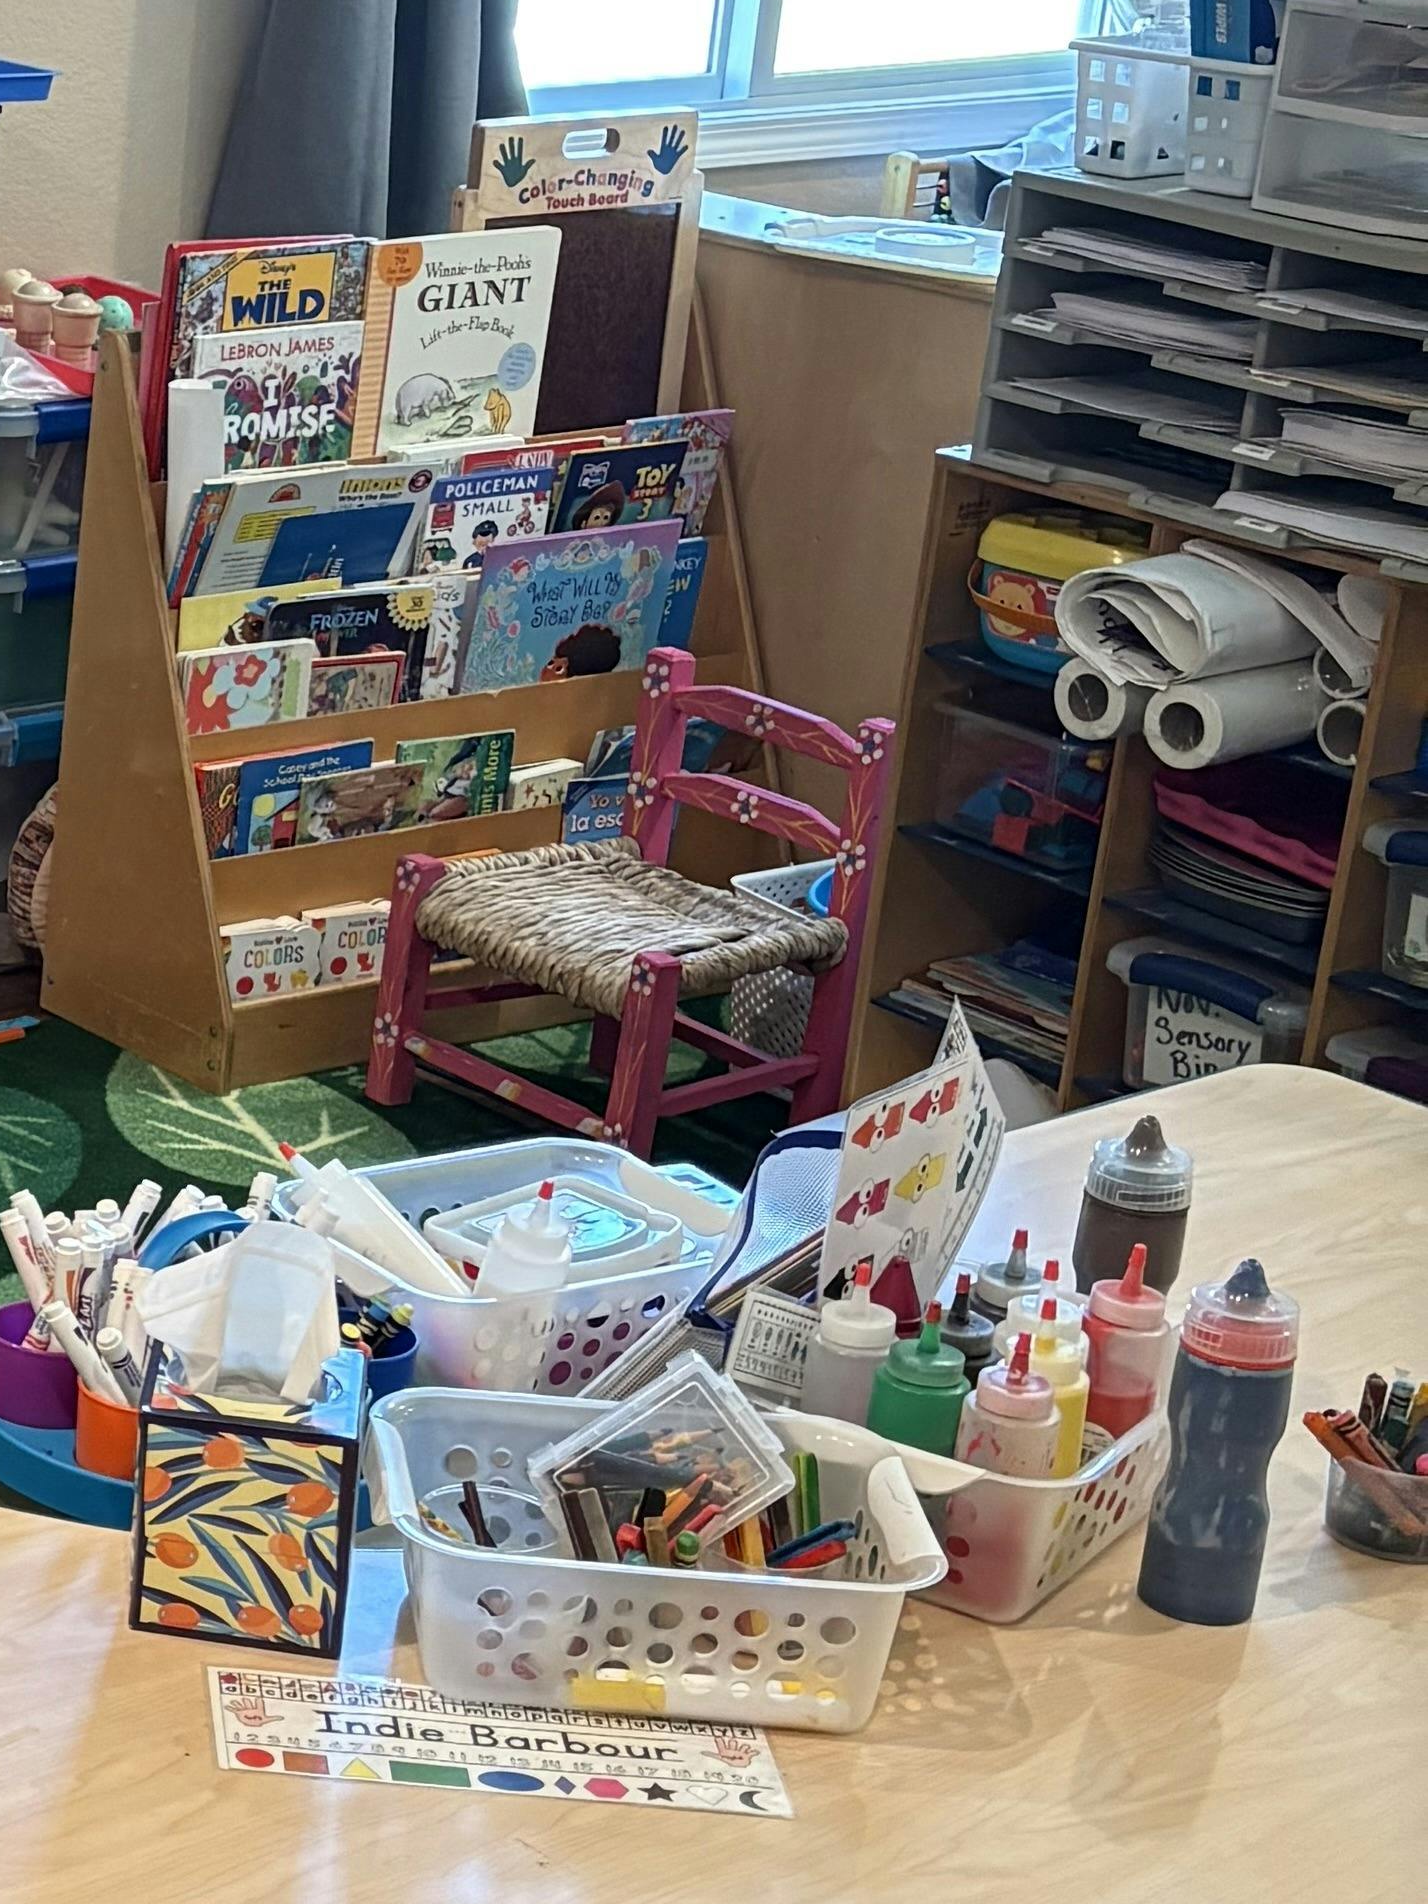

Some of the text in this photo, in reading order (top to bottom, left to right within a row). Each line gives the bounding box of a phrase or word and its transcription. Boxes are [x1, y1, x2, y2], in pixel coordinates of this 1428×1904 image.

[518, 168, 654, 203] Color-Changing
[545, 190, 628, 209] Touch Board
[258, 278, 290, 291] THE
[417, 276, 530, 312] GIANT
[232, 287, 324, 326] WILD
[285, 336, 334, 356] JAMES
[445, 474, 537, 498] POLICEMAN
[636, 464, 675, 488] TOY
[462, 498, 514, 516] SMALL
[310, 608, 378, 629] FROZEN
[243, 945, 303, 967] COLORS
[1154, 1016, 1252, 1064] Sensory
[313, 1709, 678, 1760] Indie Barbour
